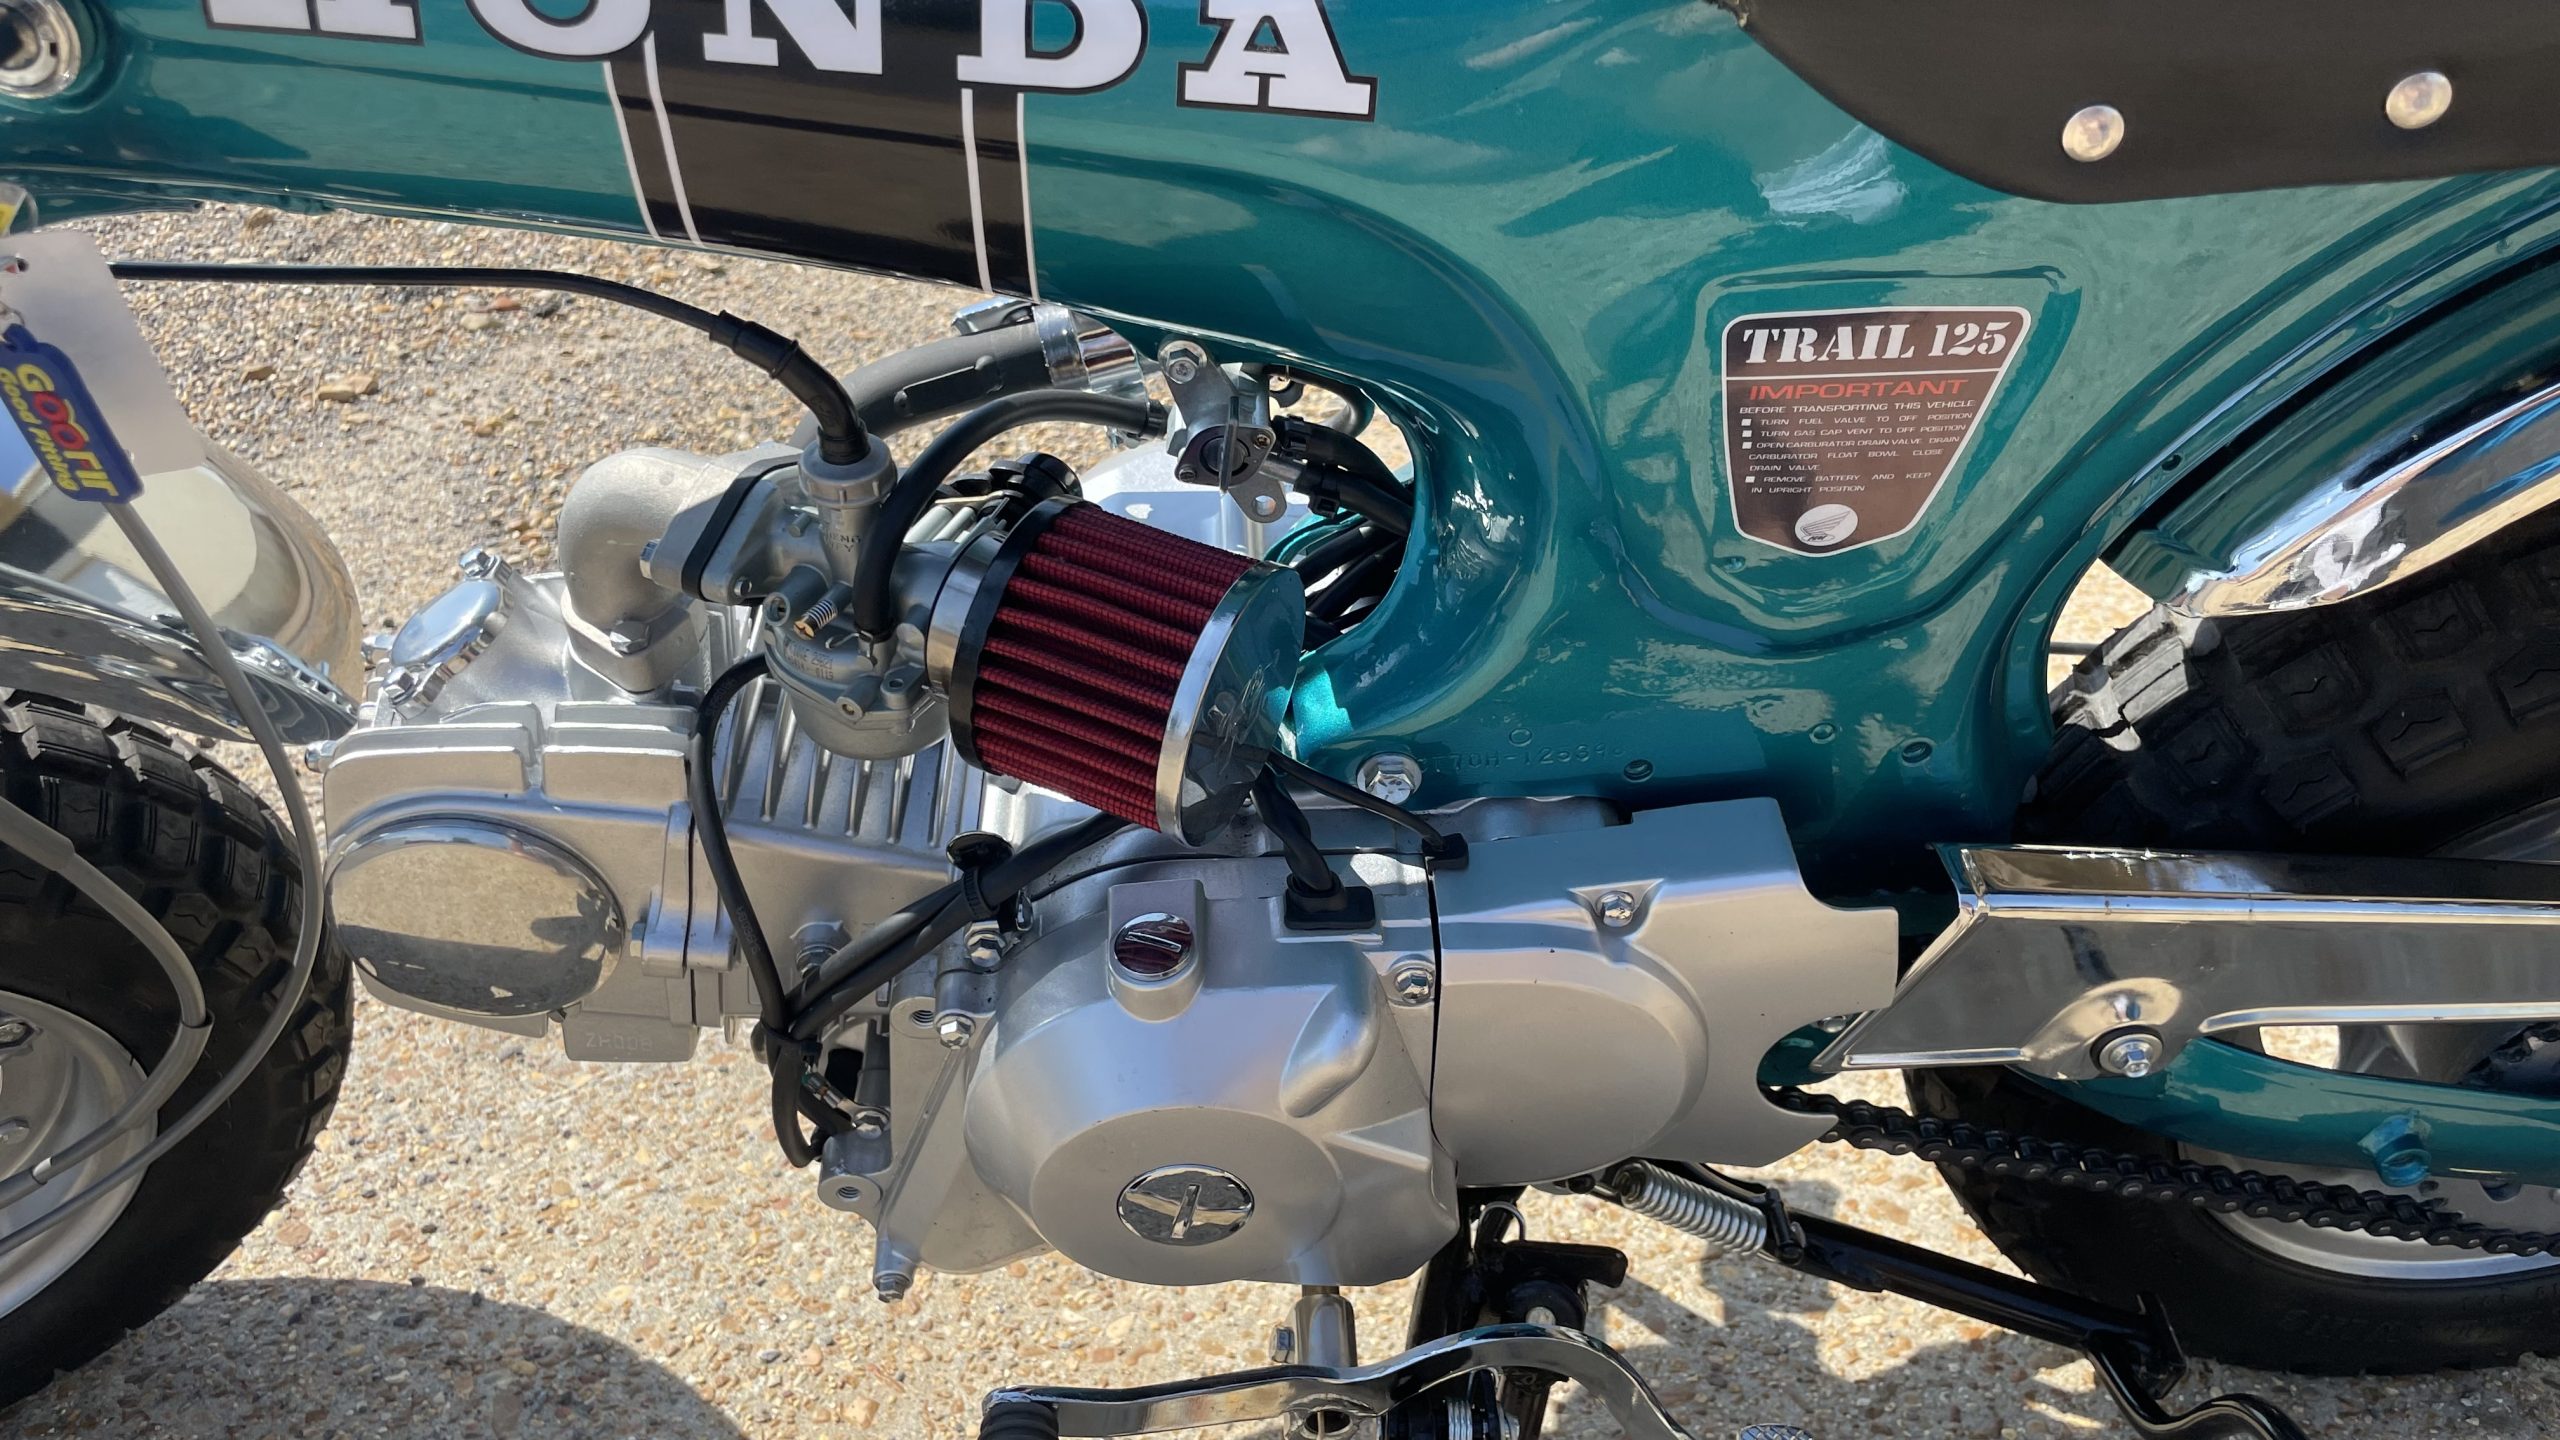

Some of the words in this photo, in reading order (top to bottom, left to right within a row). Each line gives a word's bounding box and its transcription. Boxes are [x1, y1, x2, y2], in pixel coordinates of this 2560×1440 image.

[207, 0, 1377, 121] NDA
[1743, 324, 1914, 363] TRAIL
[1928, 322, 2011, 357] 125
[1750, 379, 1969, 400] IMPORTANT
[1740, 406, 1786, 414] BEFORE
[1792, 403, 1888, 413] TRANSPORTING
[1894, 402, 1921, 410] THIS
[1927, 400, 1975, 409] VEHICLE
